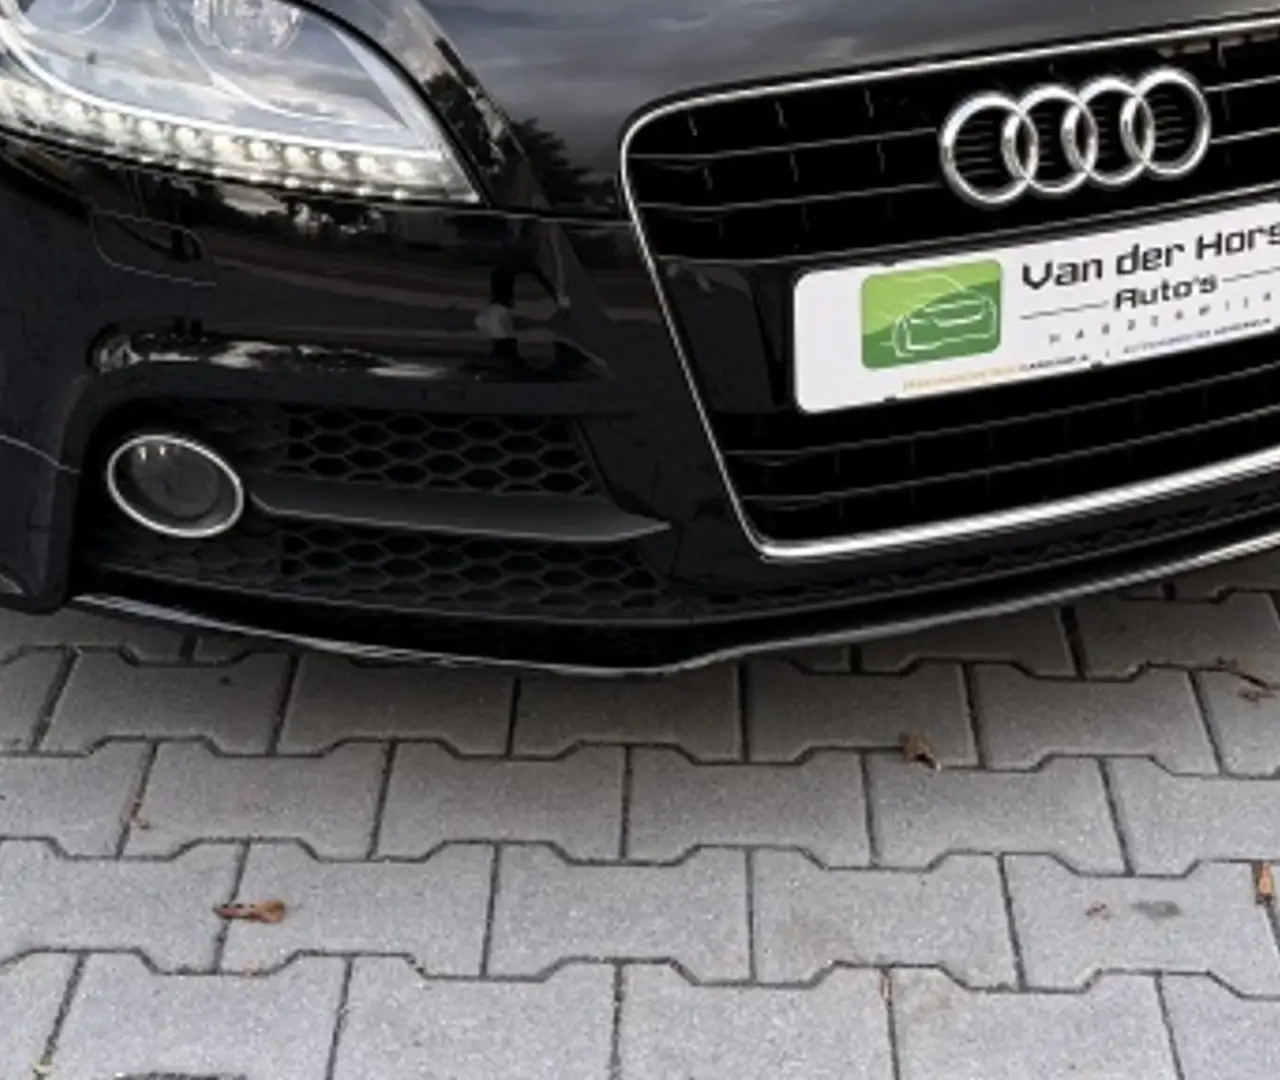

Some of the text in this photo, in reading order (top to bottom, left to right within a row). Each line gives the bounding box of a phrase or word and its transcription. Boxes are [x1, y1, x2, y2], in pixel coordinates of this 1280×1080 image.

[1022, 255, 1105, 291] Van
[1116, 240, 1187, 277] der
[1113, 271, 1219, 313] Auto's
